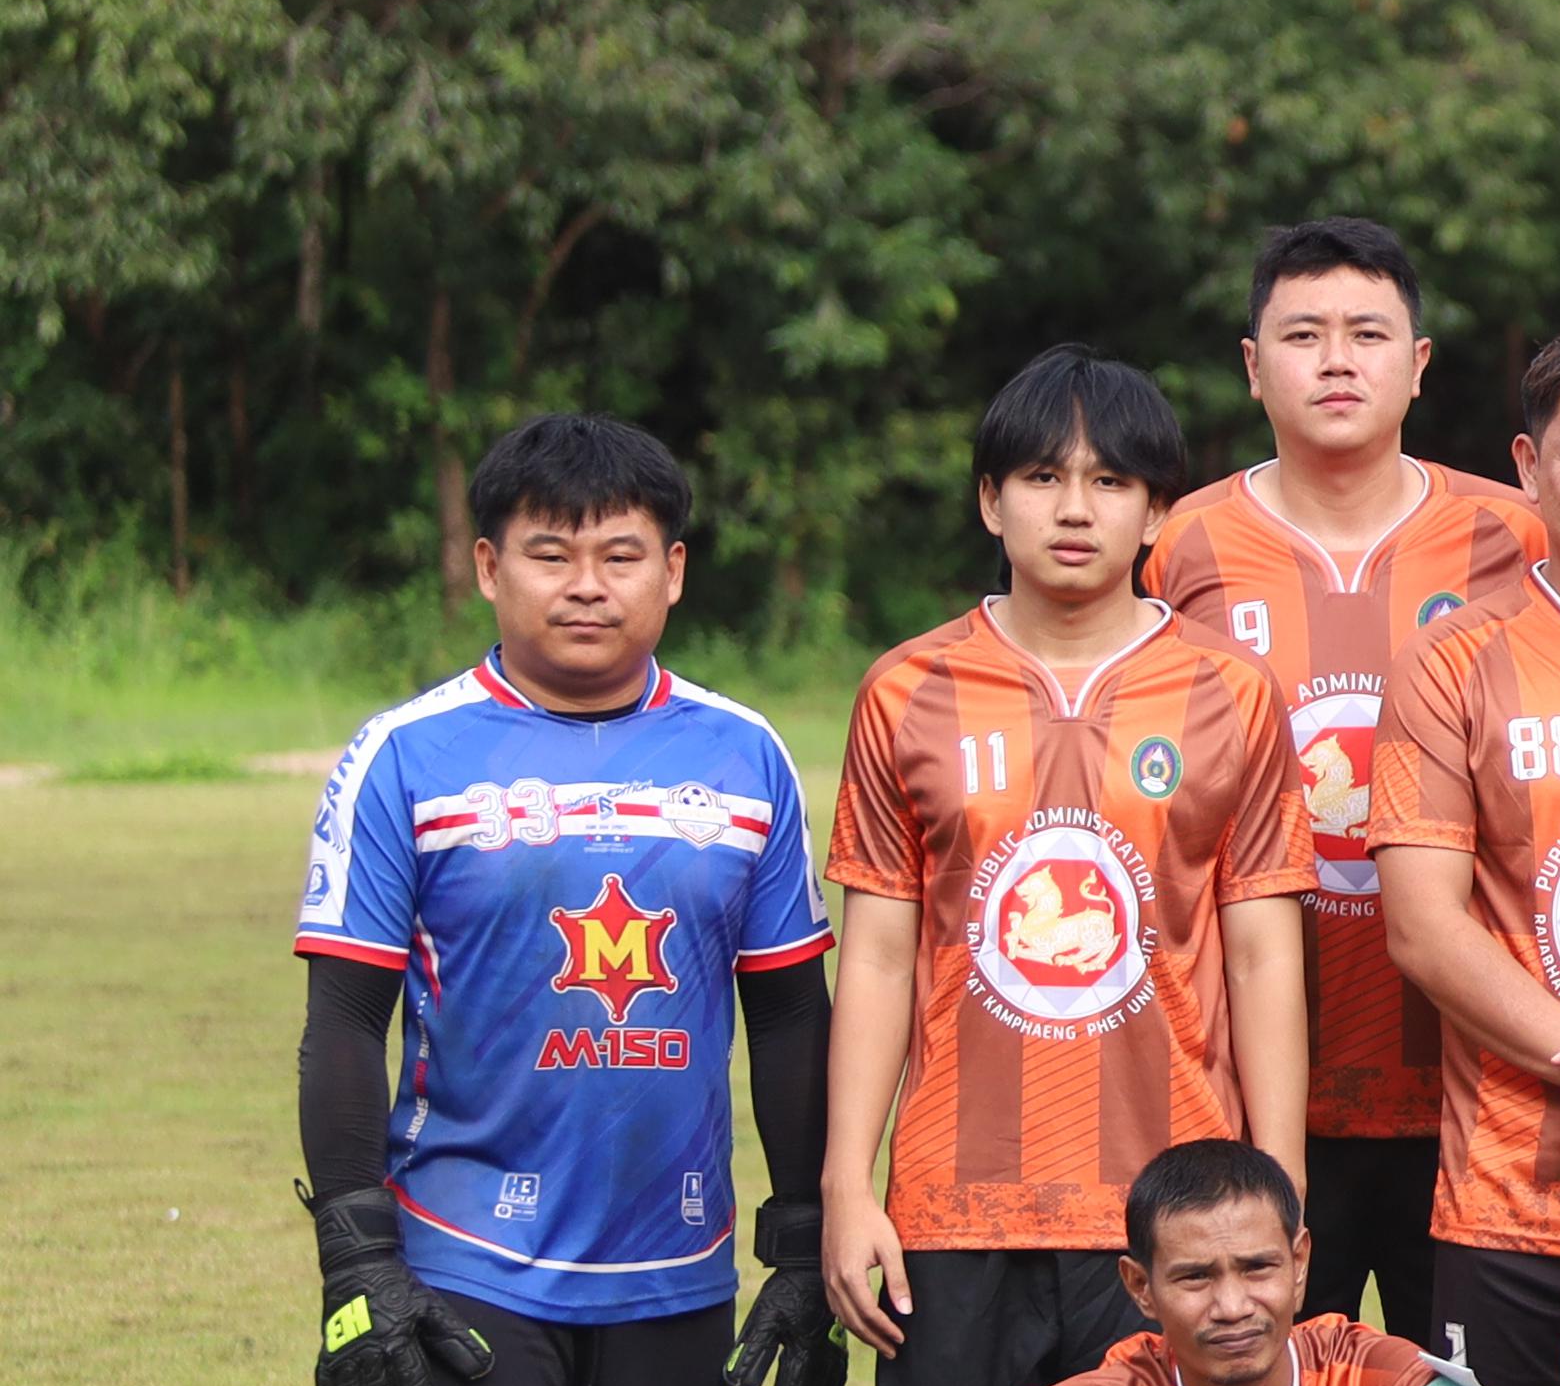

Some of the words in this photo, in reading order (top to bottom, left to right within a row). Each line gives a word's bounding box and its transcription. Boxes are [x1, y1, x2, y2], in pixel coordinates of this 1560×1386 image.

[1230, 598, 1272, 657] 9
[960, 730, 1007, 794] 11
[463, 777, 560, 851] 33
[970, 830, 1021, 901] PUBLIC
[578, 919, 654, 981] M
[983, 992, 1077, 1041] KAMPHAENG
[1086, 1009, 1127, 1038] PHET
[535, 1027, 690, 1071] M-150
